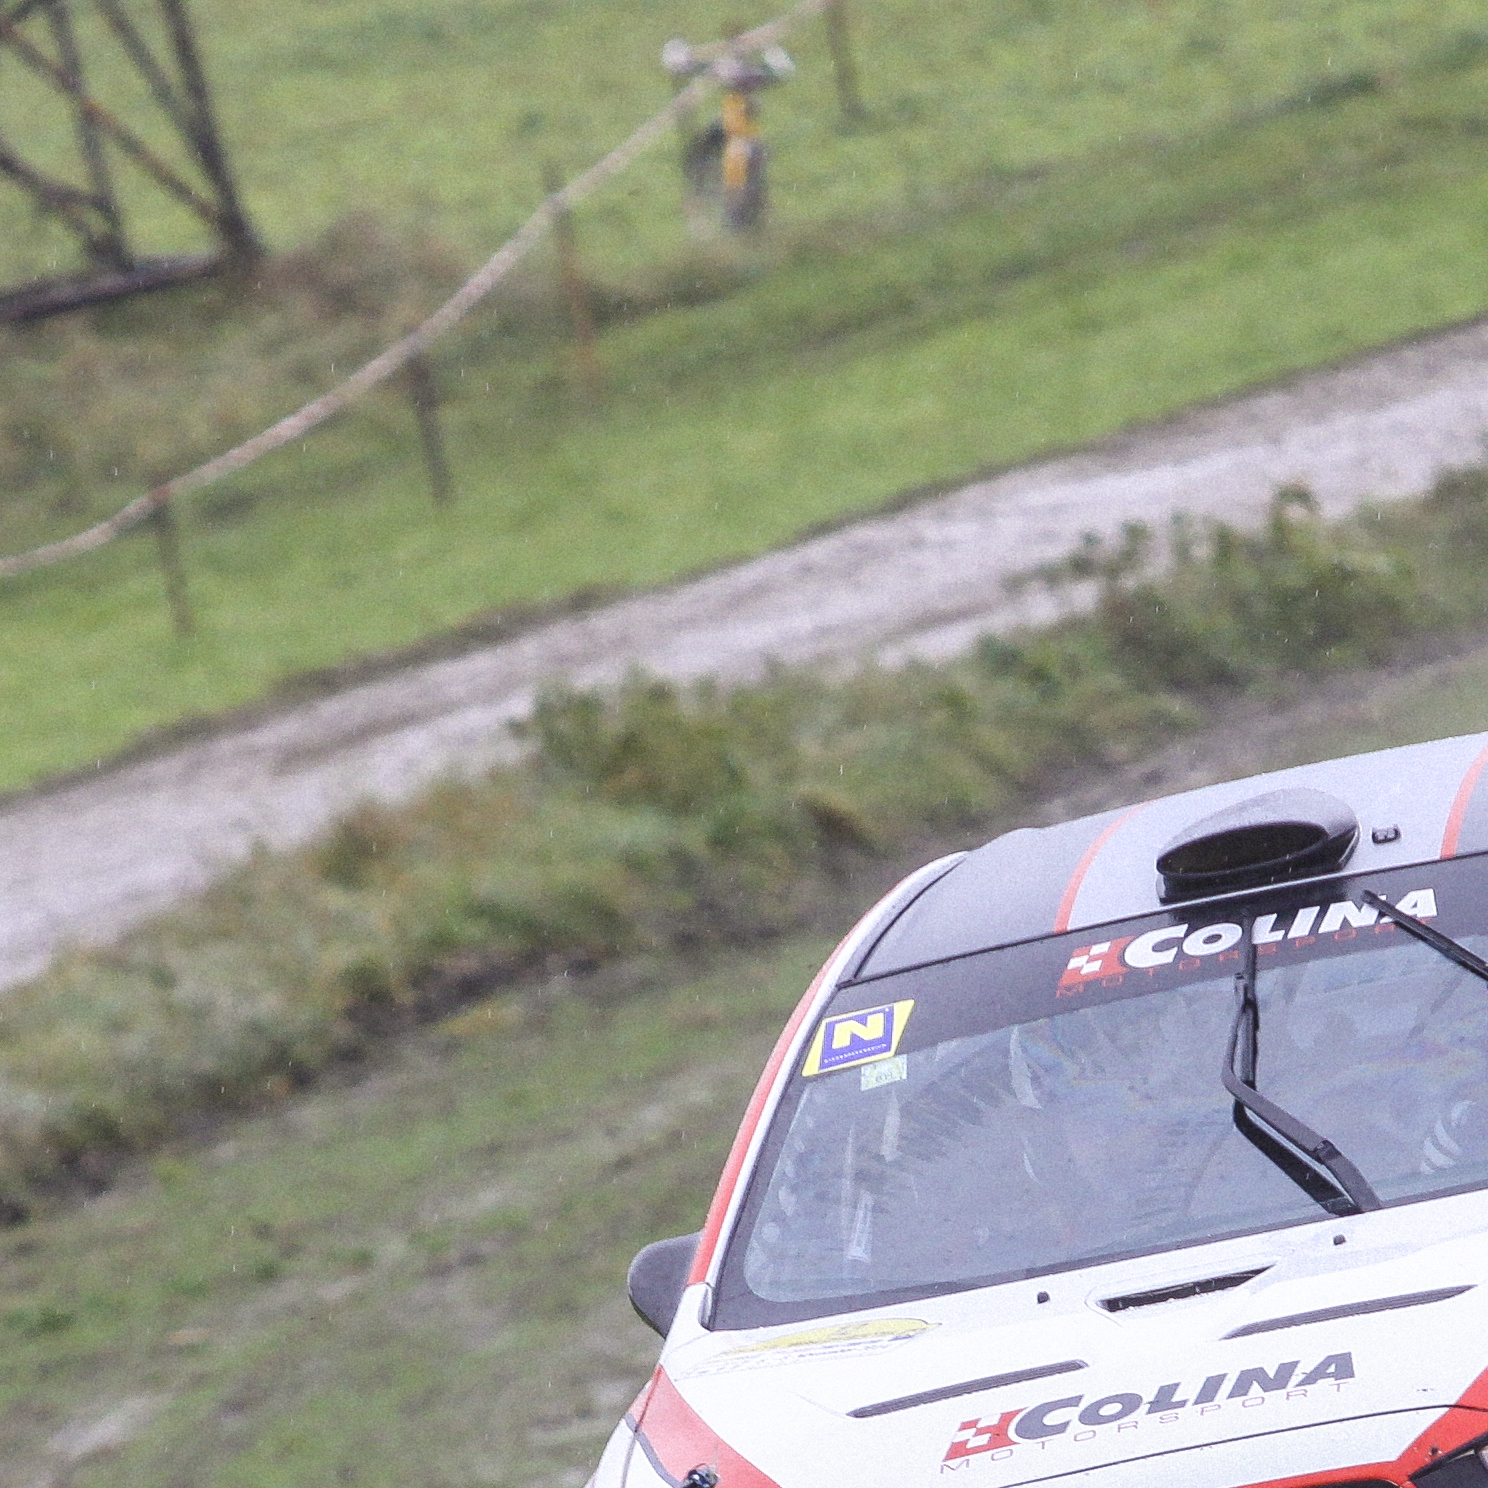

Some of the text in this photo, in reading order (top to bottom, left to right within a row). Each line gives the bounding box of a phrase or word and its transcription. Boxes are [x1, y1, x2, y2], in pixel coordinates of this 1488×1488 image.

[1123, 888, 1438, 969] COLINA
[831, 1011, 885, 1050] N
[940, 1382, 1346, 1474] MOTORSPORT
[1013, 1351, 1356, 1441] COLINA
